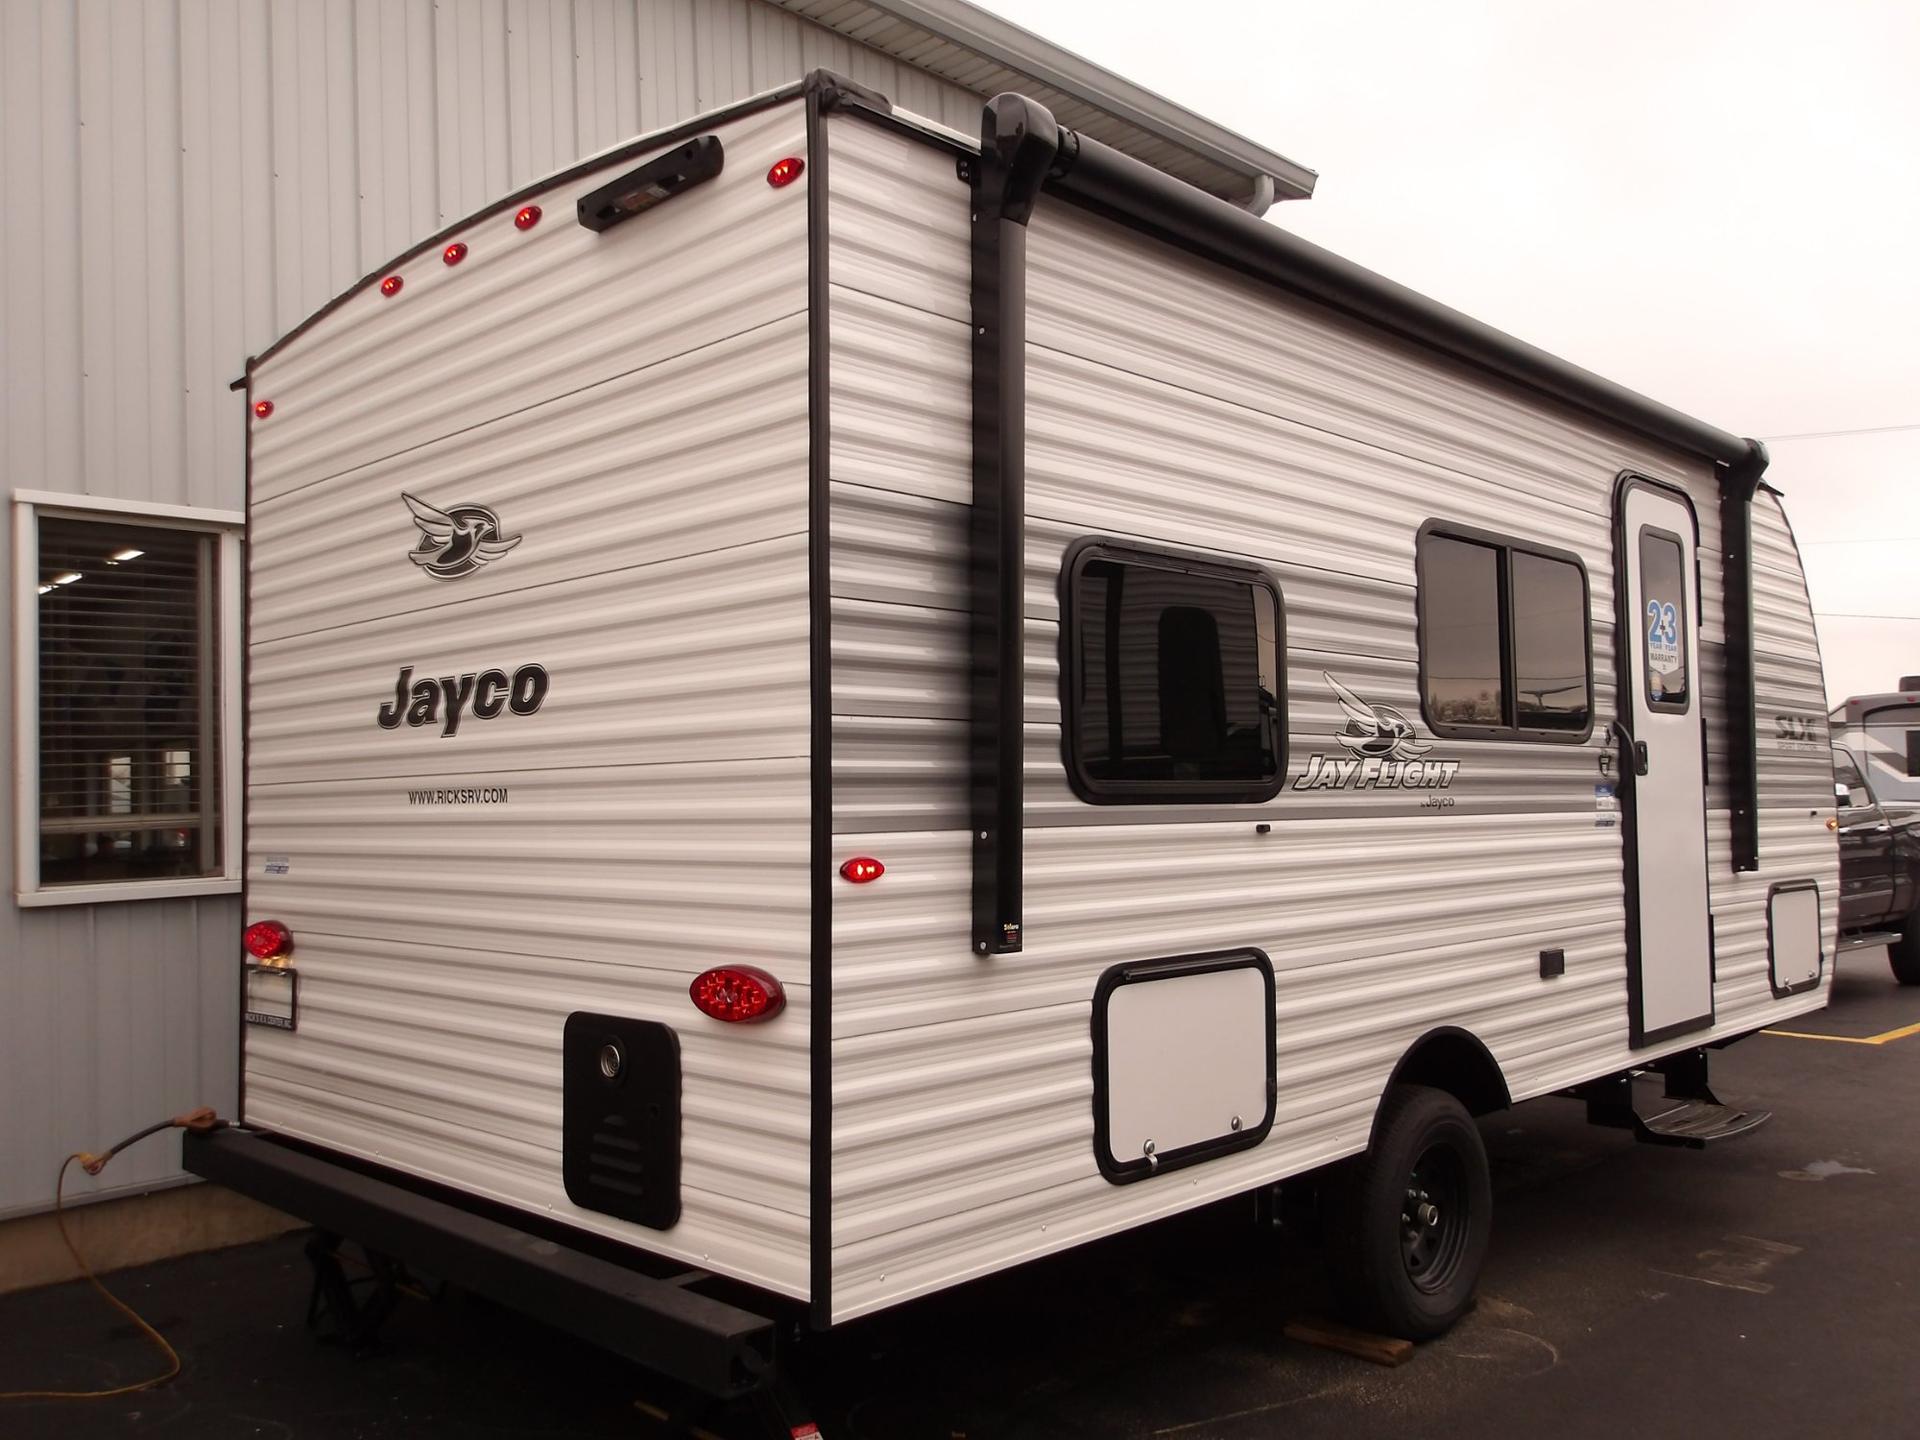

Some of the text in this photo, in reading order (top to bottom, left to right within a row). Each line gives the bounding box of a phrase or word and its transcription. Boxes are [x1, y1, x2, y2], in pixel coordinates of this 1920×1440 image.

[1650, 652, 1677, 663] WARRANTY
[377, 663, 550, 738] Jayco
[1292, 753, 1460, 790] JAY FLIGHT
[408, 788, 508, 804] WWW.RICKSRV.COM
[1426, 794, 1455, 810] Jayco
